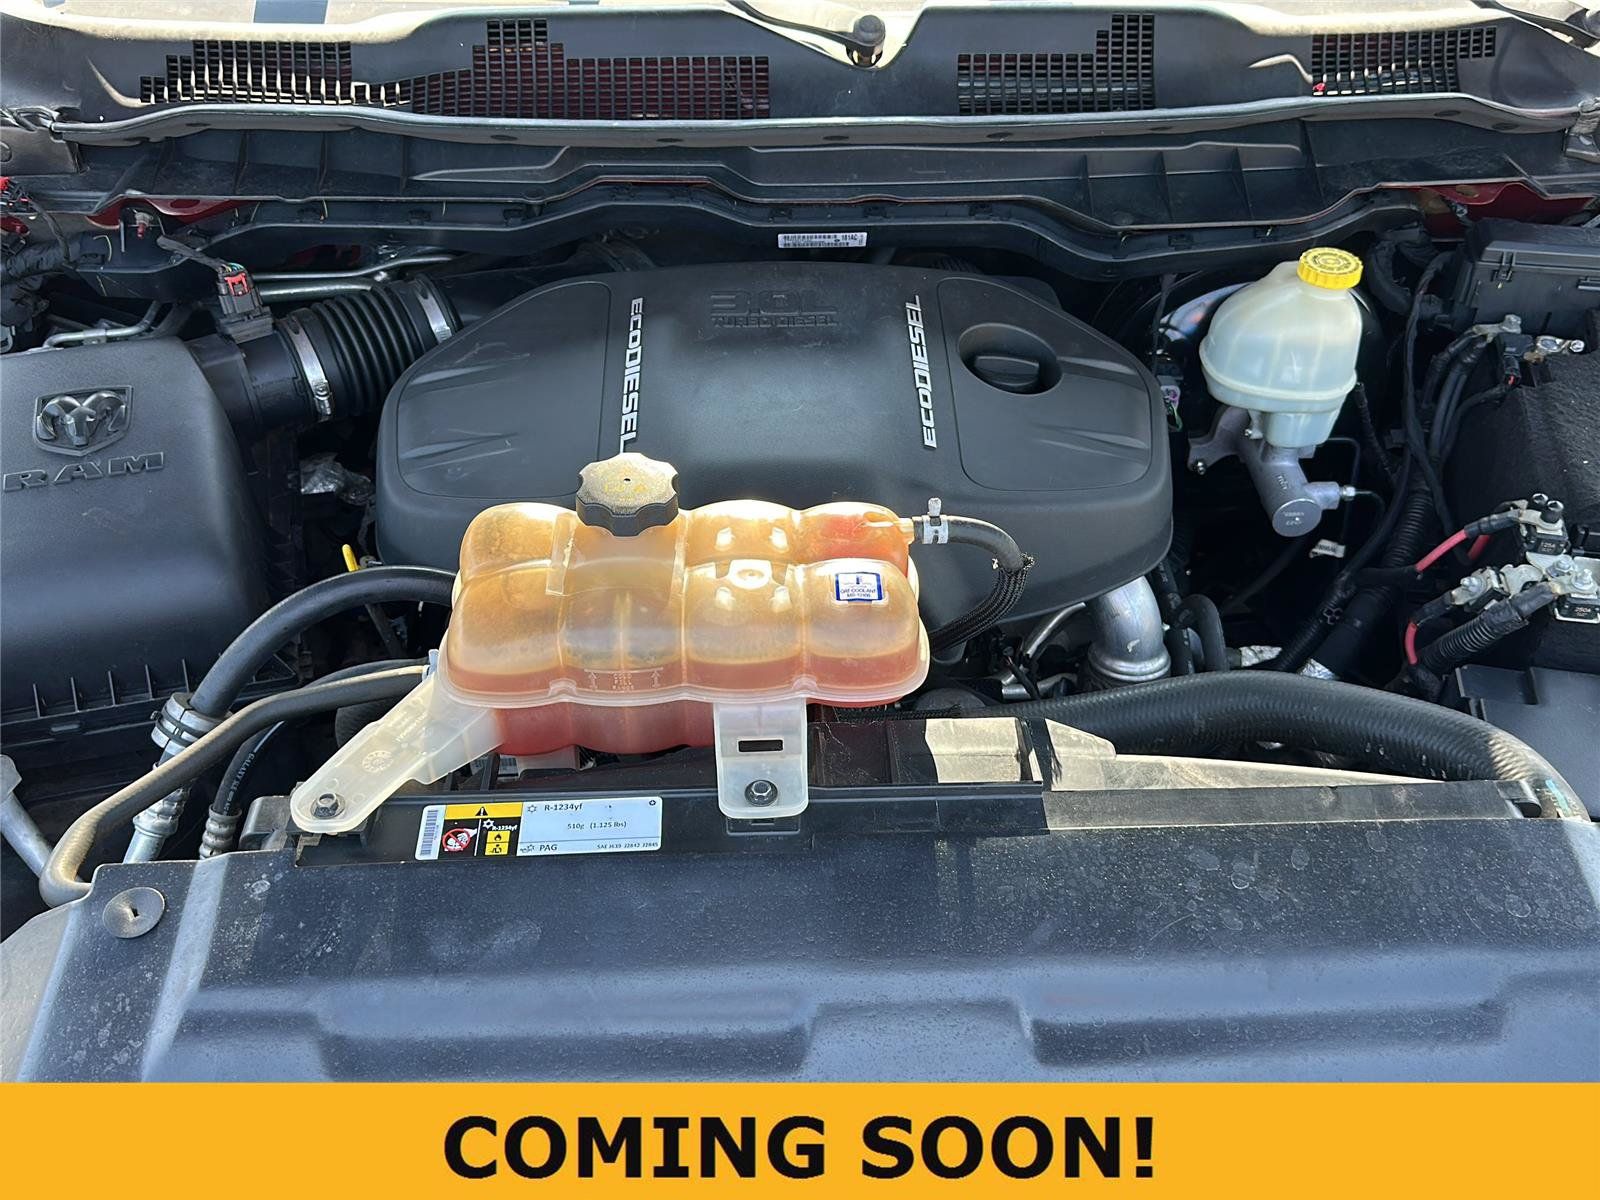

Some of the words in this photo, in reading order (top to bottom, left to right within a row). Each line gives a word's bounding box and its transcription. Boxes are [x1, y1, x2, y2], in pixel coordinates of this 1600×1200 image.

[619, 297, 643, 453] ECODIESEL
[905, 294, 937, 449] ECODIESEL
[3, 451, 164, 492] RAM
[544, 803, 583, 812] R-1234yf
[567, 823, 585, 831] 510g
[589, 821, 613, 830] (1.125
[614, 820, 627, 829] lbs)
[539, 843, 558, 852] PAG
